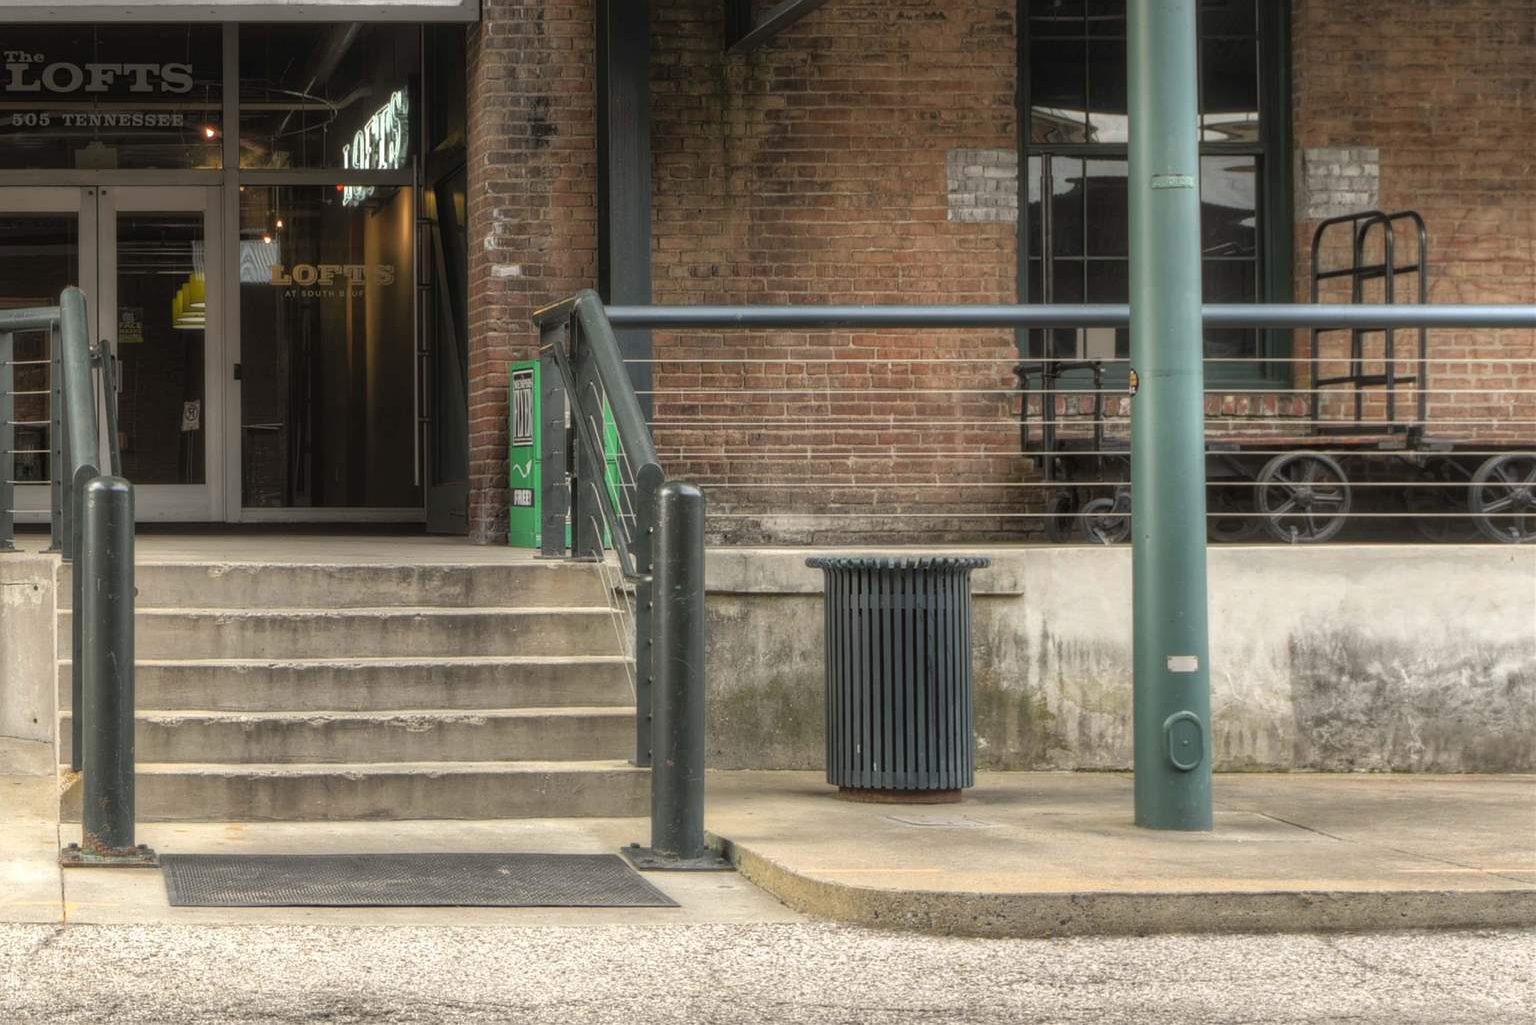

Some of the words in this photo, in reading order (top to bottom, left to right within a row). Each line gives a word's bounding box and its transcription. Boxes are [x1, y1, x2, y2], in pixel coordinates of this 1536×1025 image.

[4, 51, 45, 63] The
[5, 62, 194, 93] LOFTS
[13, 113, 50, 126] 505
[62, 114, 184, 126] TENNESSEE
[271, 264, 395, 286] LOFTS
[284, 289, 297, 297] AT
[301, 289, 335, 297] SOUTH
